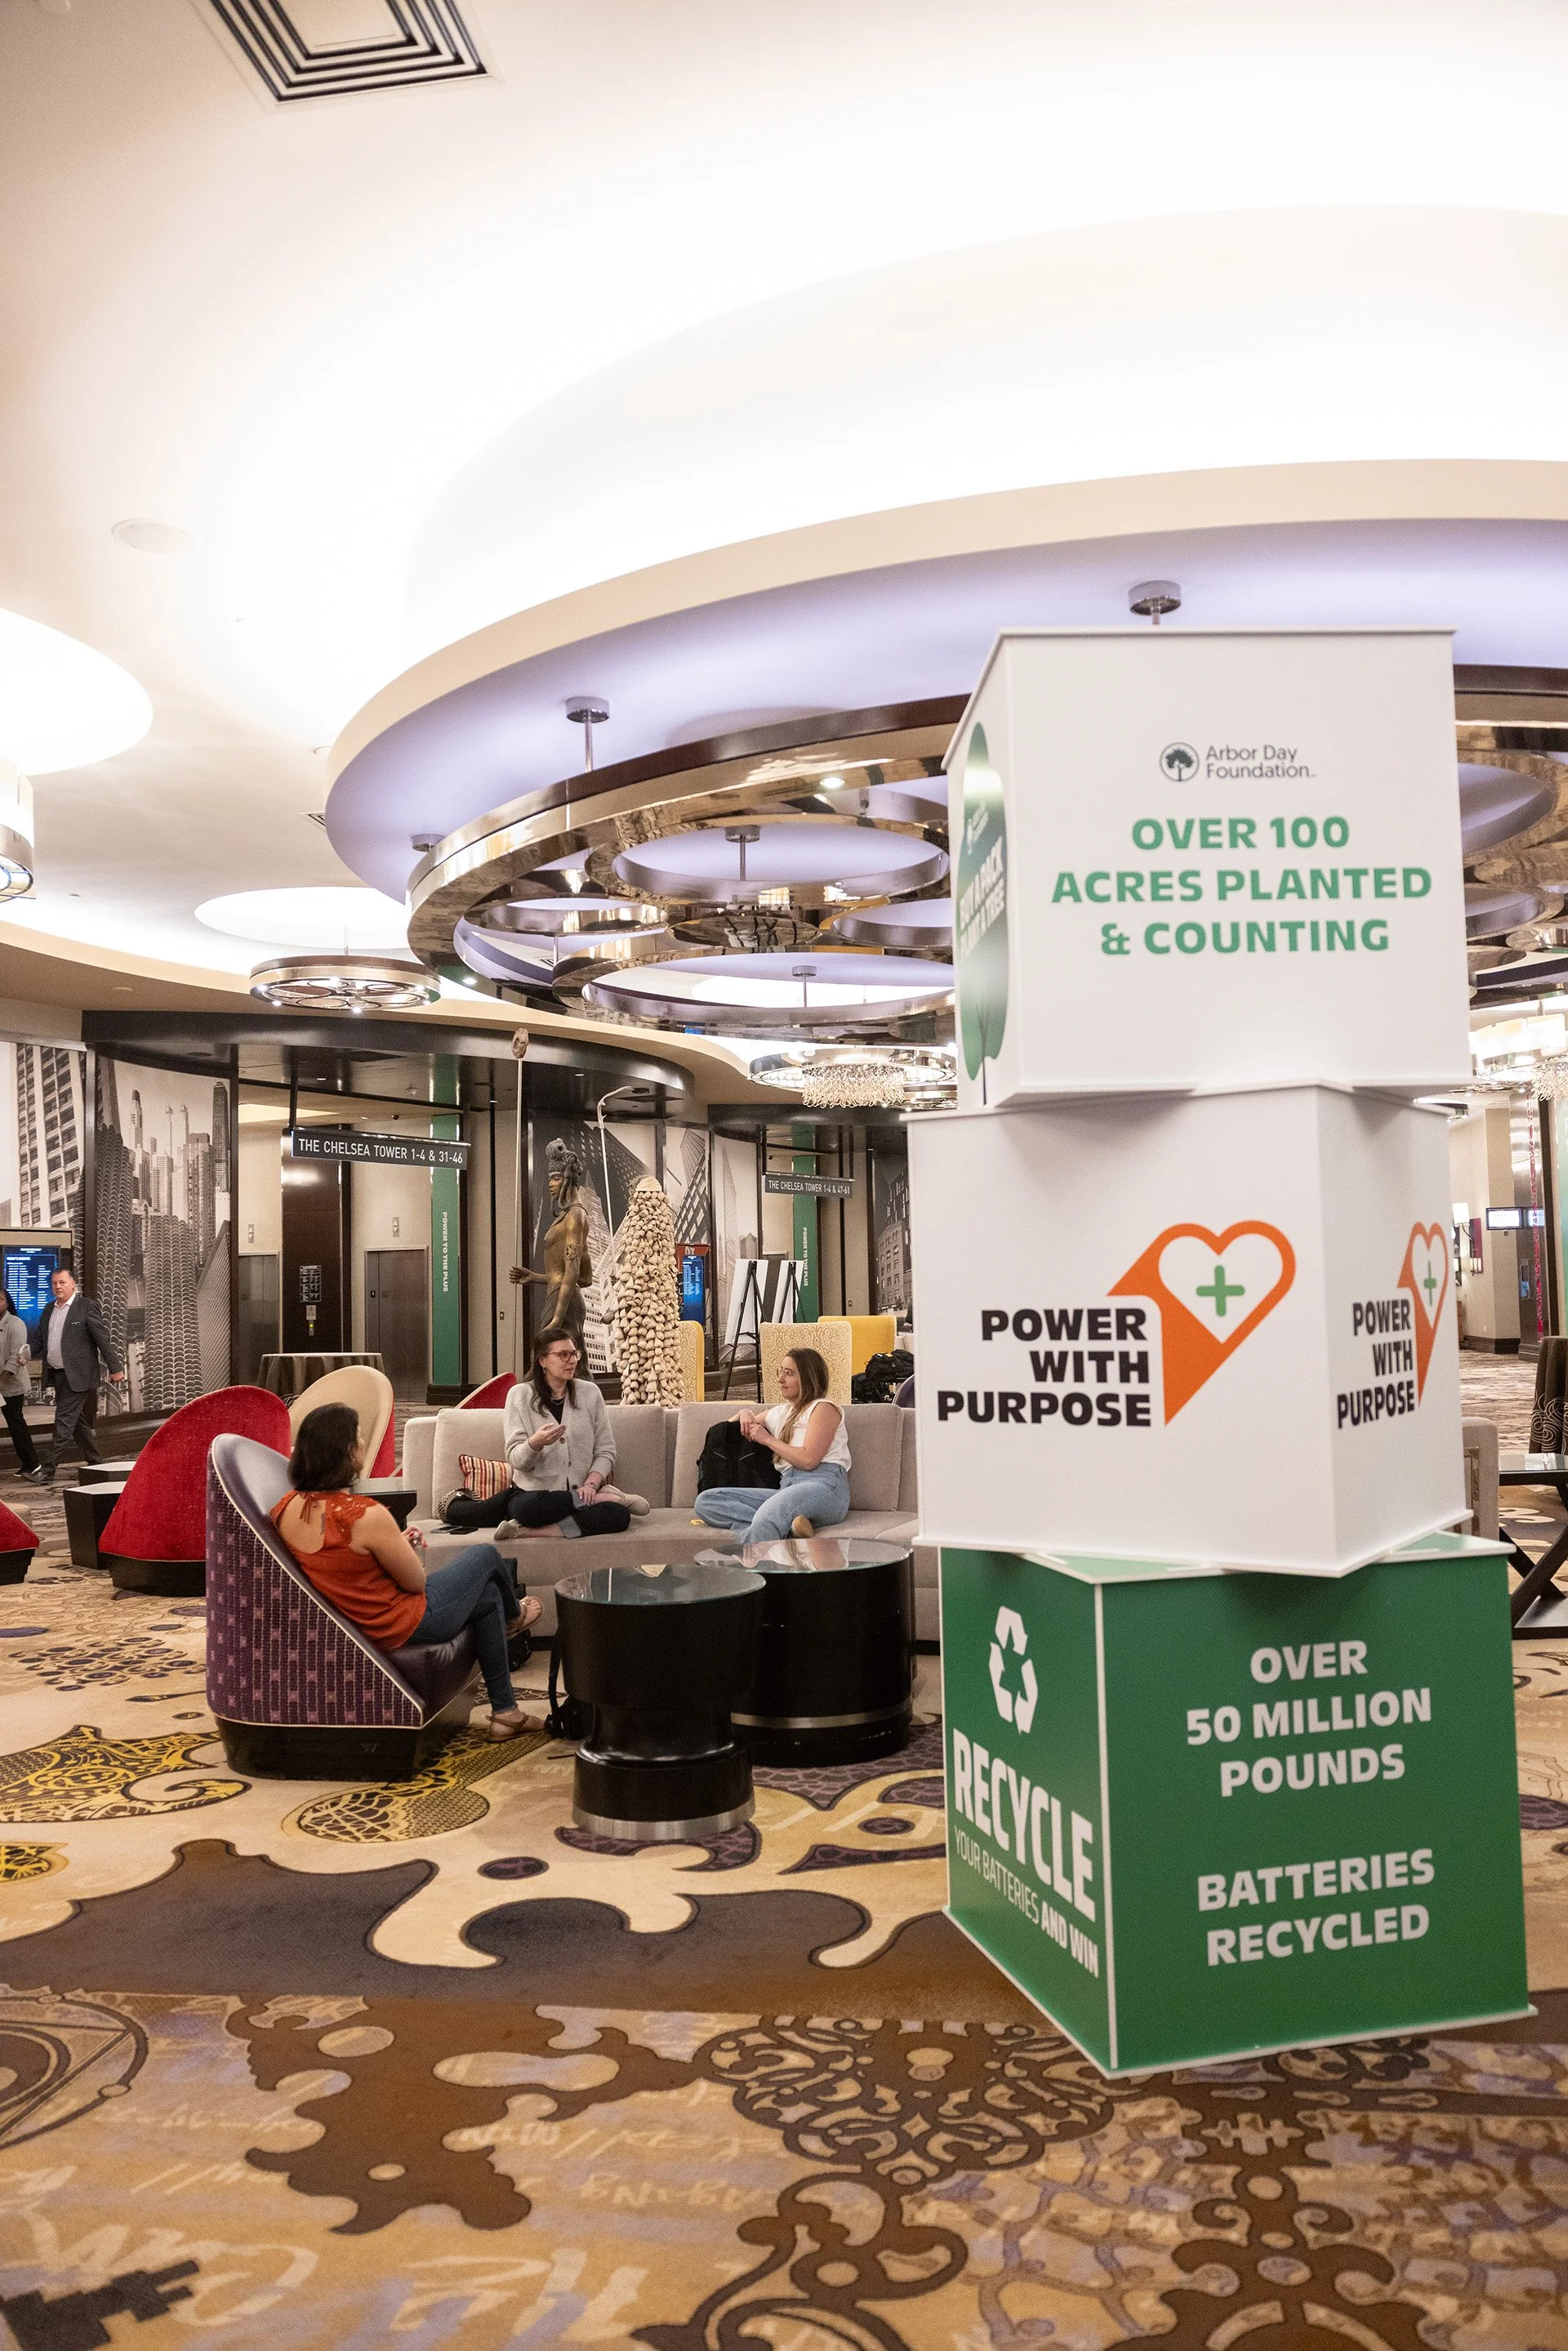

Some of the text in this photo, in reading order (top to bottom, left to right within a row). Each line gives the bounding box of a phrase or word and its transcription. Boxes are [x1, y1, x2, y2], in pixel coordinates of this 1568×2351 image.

[1205, 744, 1298, 763] Arbor Day
[1132, 817, 1350, 850] OVER 100
[1052, 867, 1432, 903] ACRES PLANTED
[1101, 919, 1389, 955] & COUNTING
[298, 1138, 464, 1164] THE CHELSEA TOWER 1-4 & 31-46
[768, 1180, 779, 1190] THE
[780, 1181, 804, 1191] CHELSEA
[805, 1182, 822, 1192] TOWER
[443, 1242, 448, 1253] TO
[981, 1307, 1147, 1342] POWER
[1352, 1298, 1411, 1337] POWER
[1029, 1349, 1151, 1385] WITH
[1372, 1339, 1414, 1378] WITH
[937, 1390, 1152, 1428] PURPOSE
[1336, 1379, 1415, 1430] PURPOSE
[1249, 1640, 1369, 1685] OVER
[1186, 1686, 1432, 1747] 50 MILLION
[1219, 1743, 1406, 1797] POUNDS
[952, 1727, 1097, 1923] RECYCLE
[1196, 1847, 1436, 1912] BATTERIES
[954, 1825, 1099, 1979] YOUR BATTERIES AND WIN
[1206, 1904, 1431, 1967] RECYCLED
